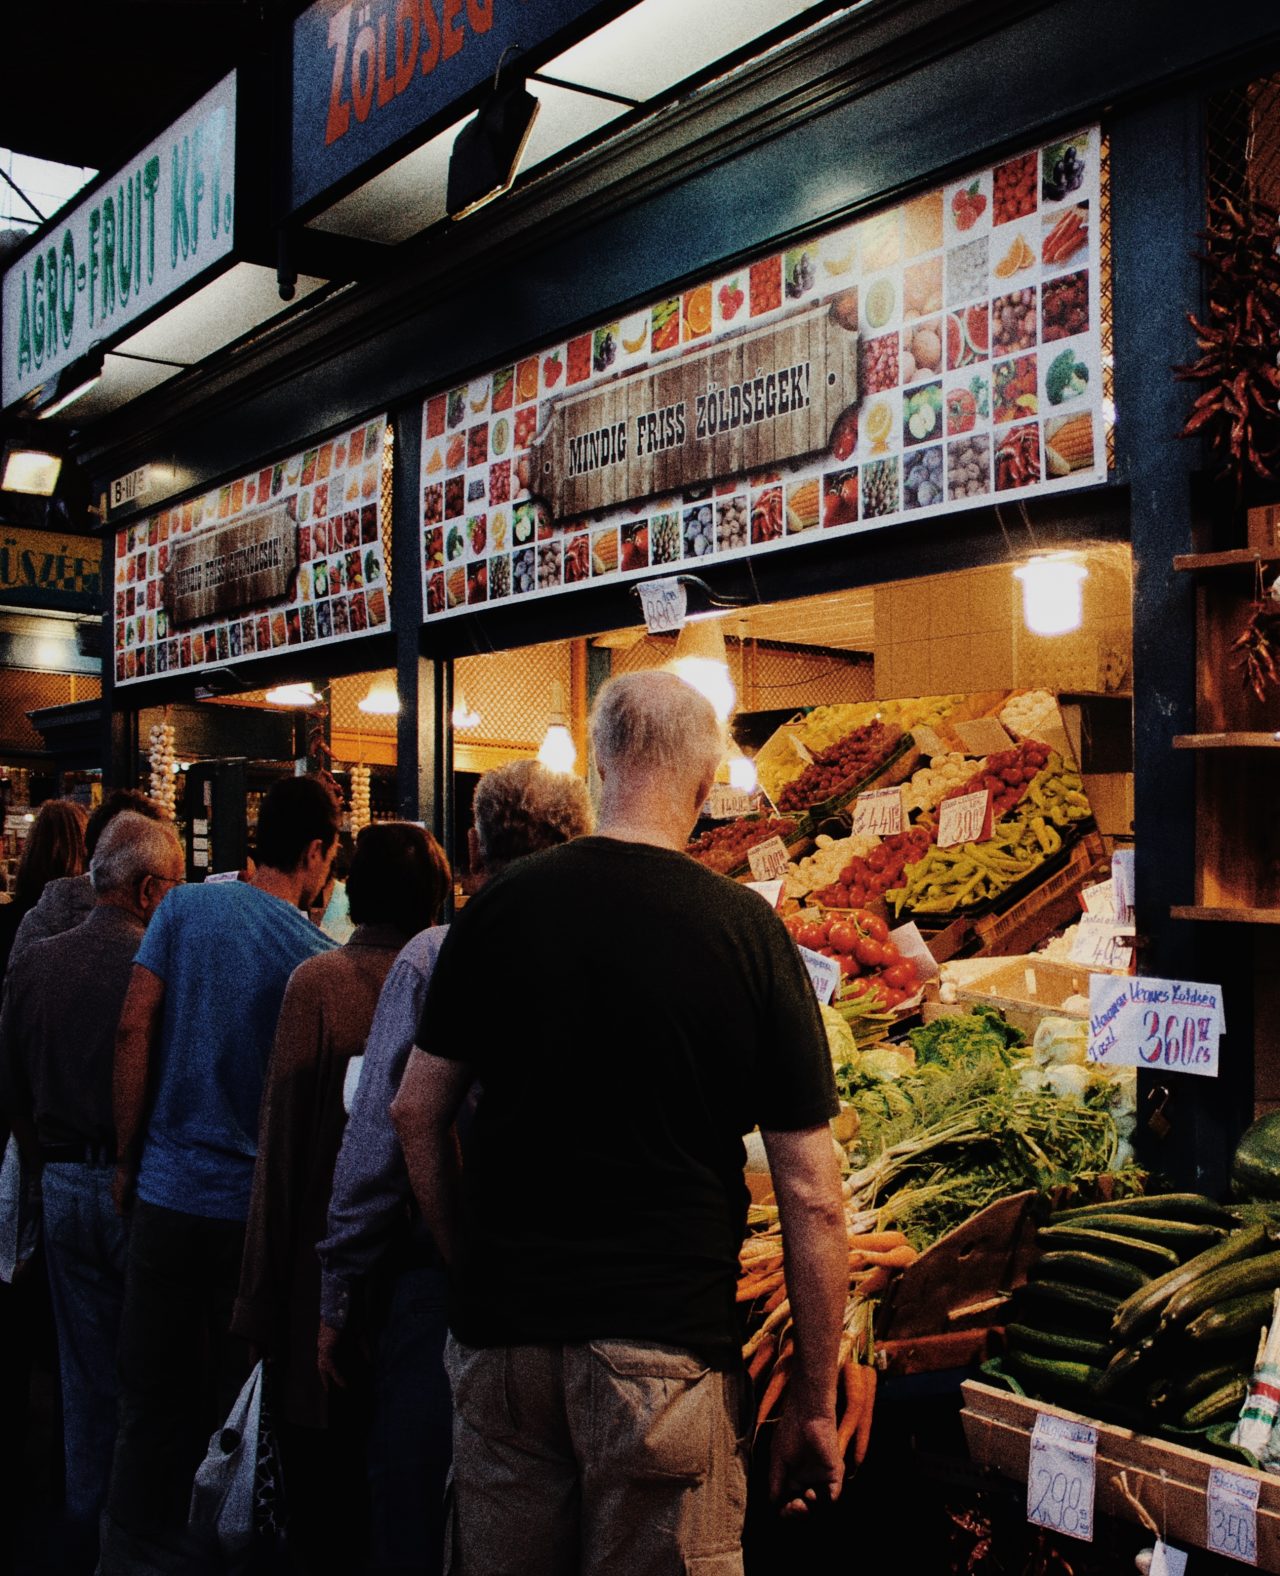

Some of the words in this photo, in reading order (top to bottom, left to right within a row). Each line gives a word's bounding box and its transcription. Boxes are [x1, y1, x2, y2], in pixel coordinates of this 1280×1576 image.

[16, 154, 160, 381] AGRO-FRUIT
[568, 421, 627, 477] MINDIG
[637, 402, 685, 456] FRISS
[696, 361, 811, 440] ZÖLDSÉGEK!
[1138, 1010, 1195, 1066] 360
[1030, 1468, 1081, 1532] 298
